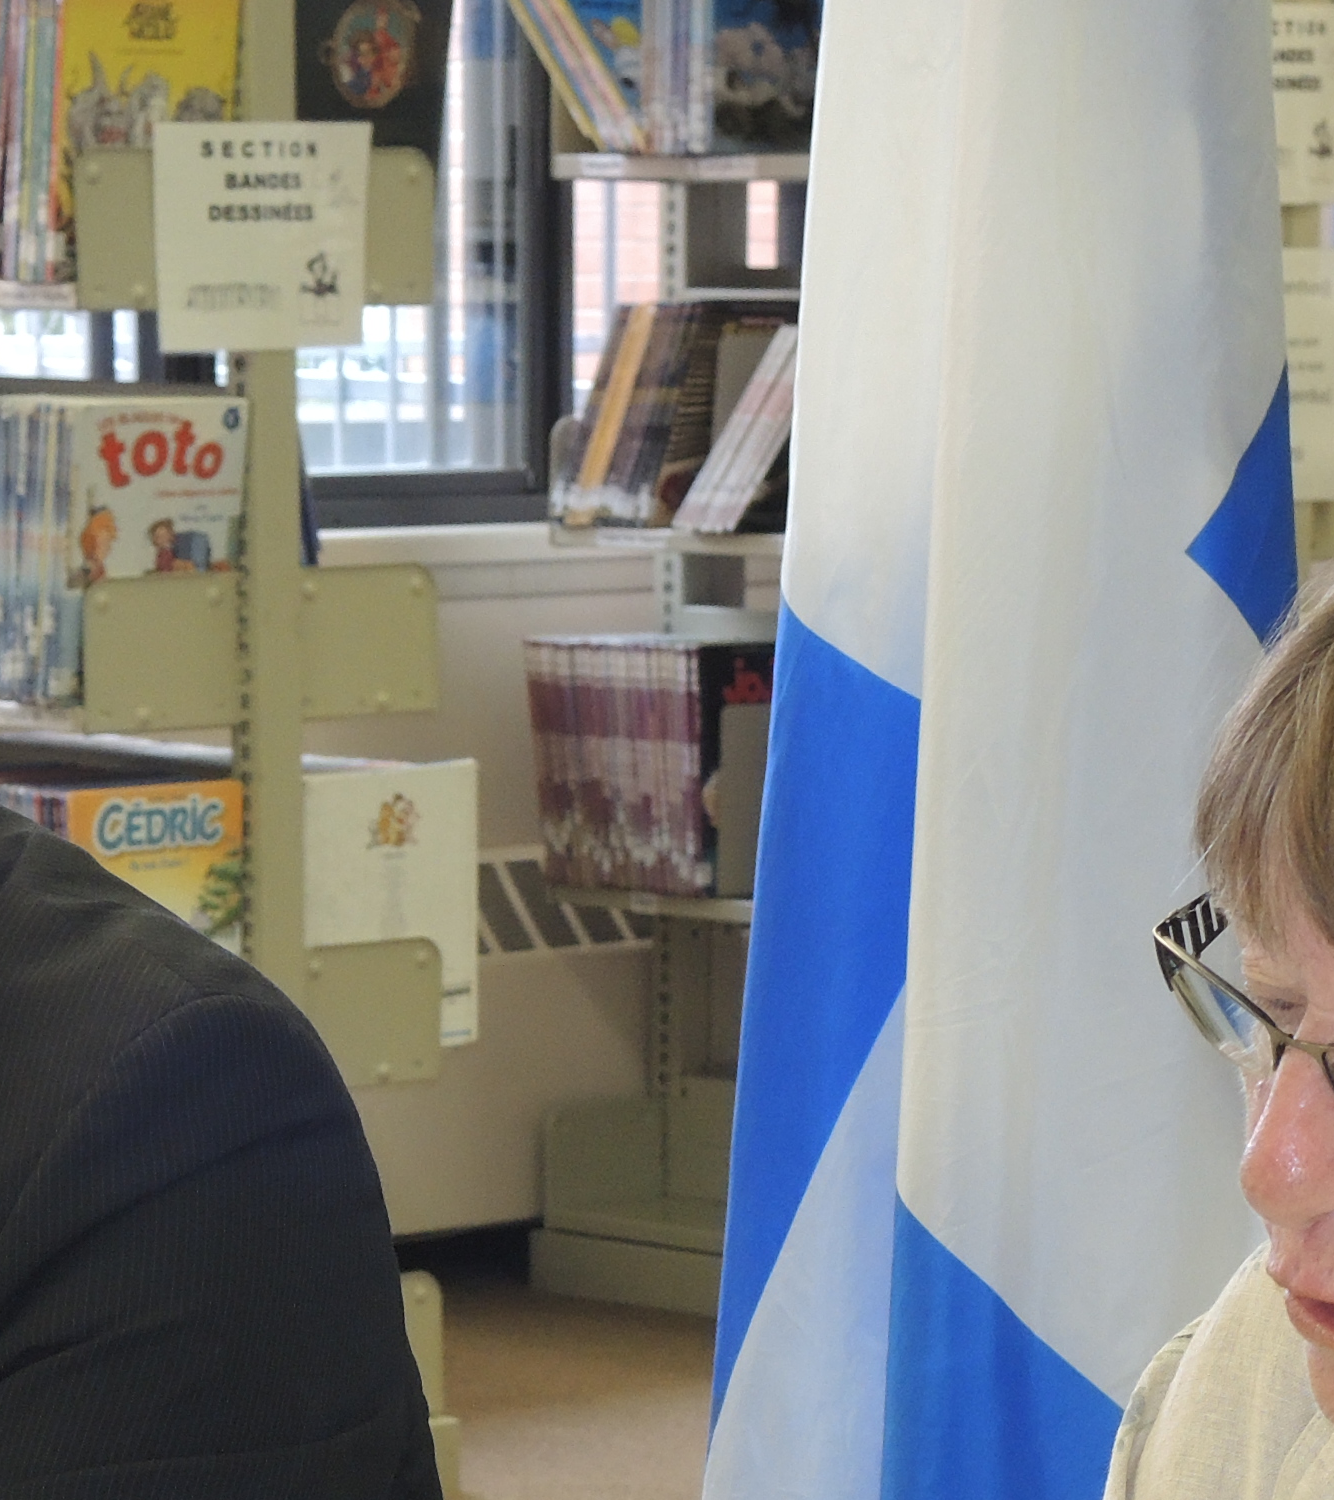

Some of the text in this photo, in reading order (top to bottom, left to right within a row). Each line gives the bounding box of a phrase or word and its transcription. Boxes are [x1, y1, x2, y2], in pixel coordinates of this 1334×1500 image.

[200, 140, 318, 159] SECTION
[224, 172, 303, 191] BANDES
[208, 203, 315, 222] DESSINÉES
[98, 419, 224, 489] toto
[97, 795, 223, 852] CÉDRIC
